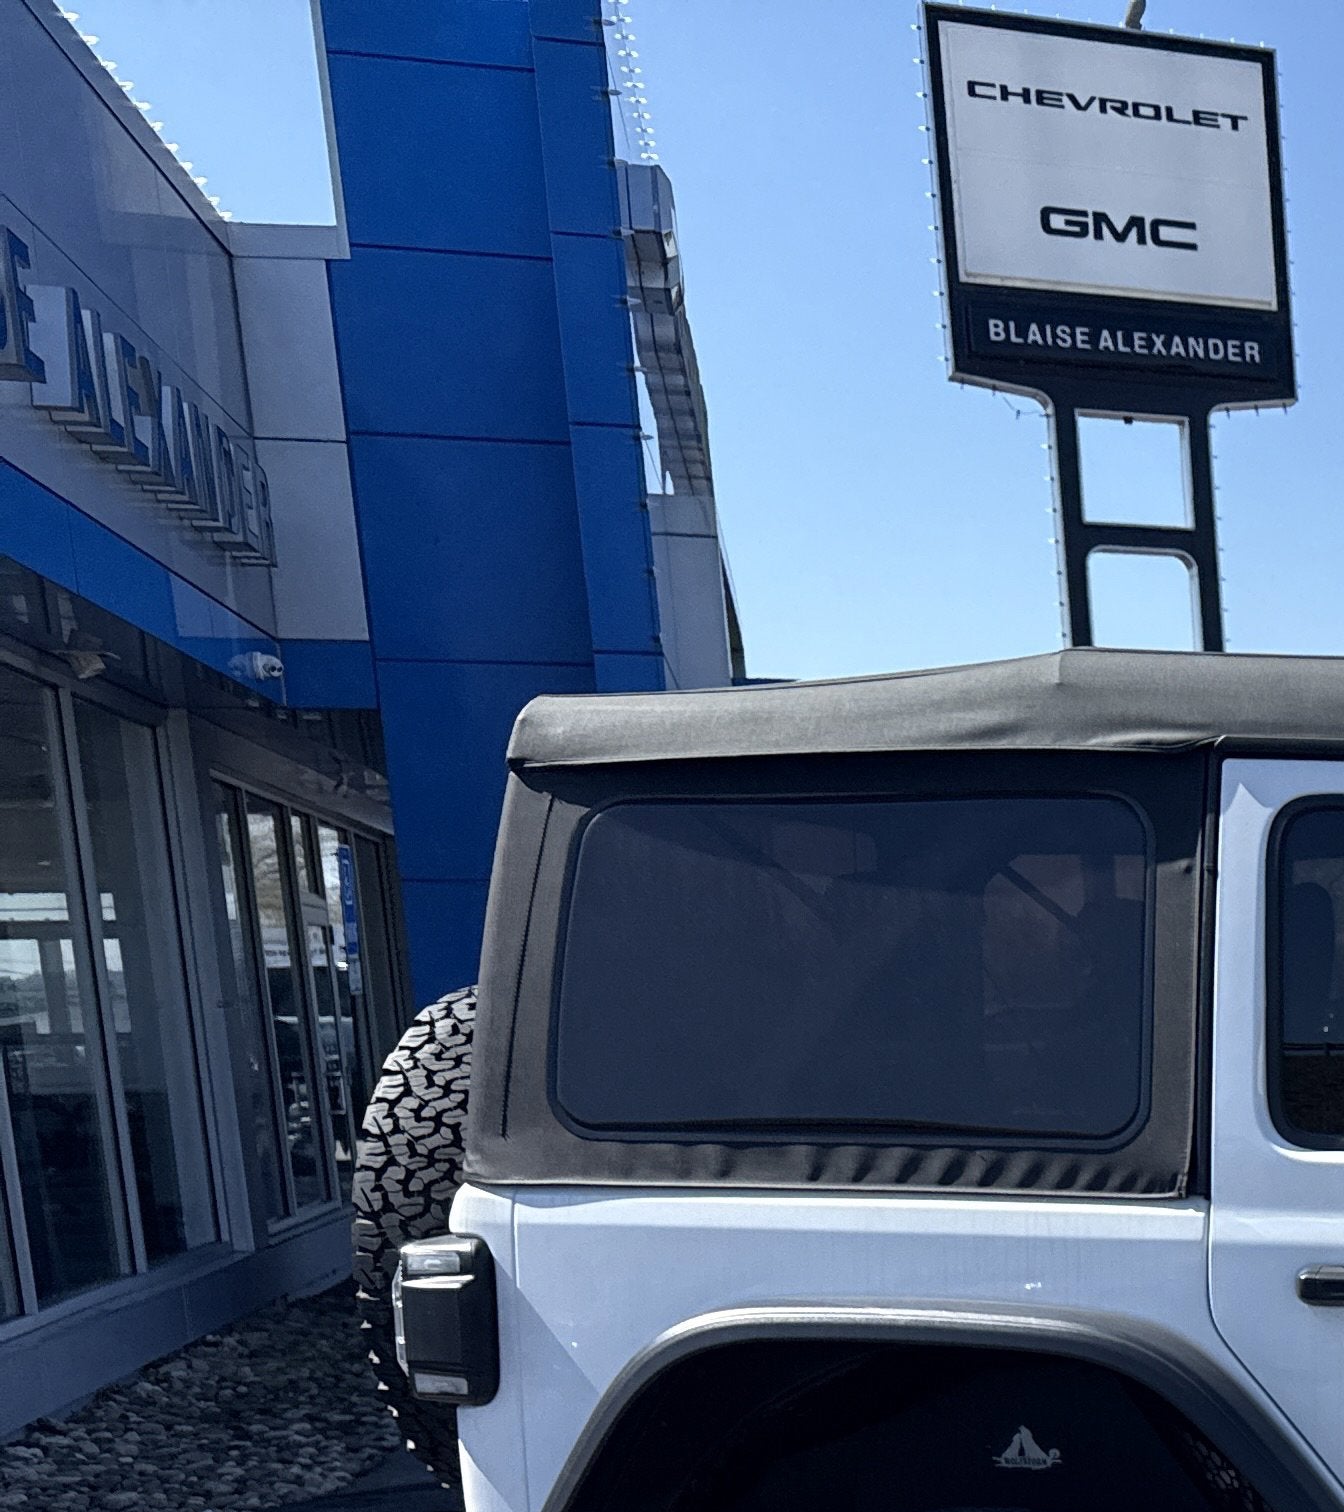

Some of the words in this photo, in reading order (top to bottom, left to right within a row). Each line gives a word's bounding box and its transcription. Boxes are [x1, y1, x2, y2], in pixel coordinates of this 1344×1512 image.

[966, 80, 1248, 132] CHEVROLET
[1040, 206, 1198, 251] GMC
[988, 318, 1092, 350] BLAISE
[1098, 329, 1262, 364] ALEXANDER
